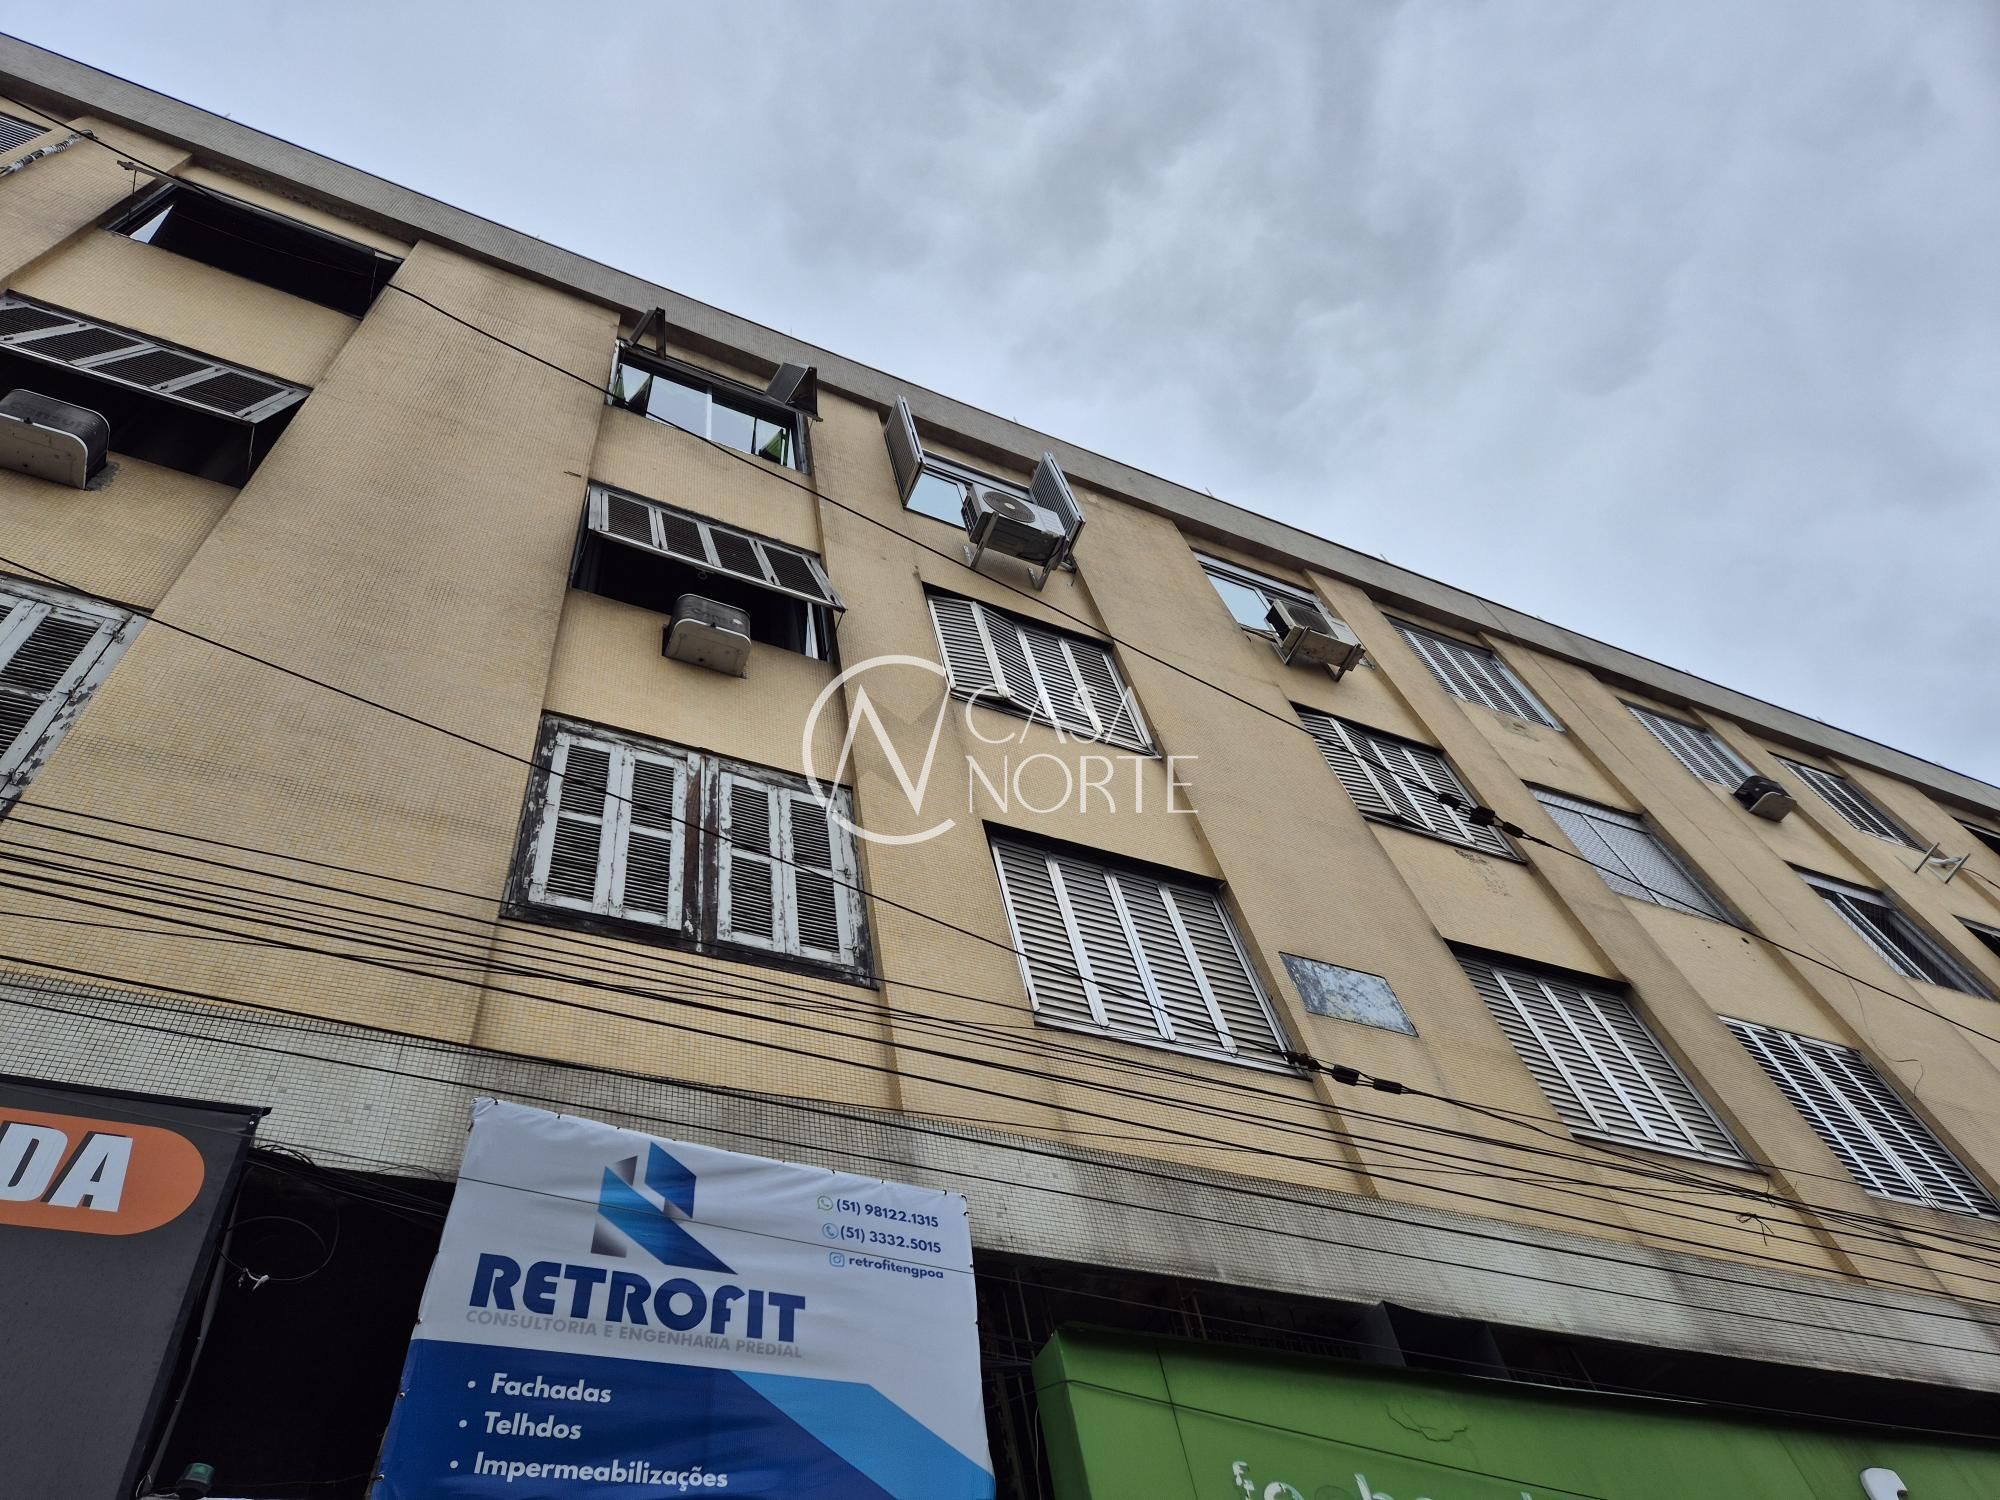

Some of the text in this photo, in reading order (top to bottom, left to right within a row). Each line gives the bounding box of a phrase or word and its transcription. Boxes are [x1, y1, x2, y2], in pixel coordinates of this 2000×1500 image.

[837, 1198, 939, 1228] (51) 98122.1315
[840, 1225, 942, 1253] (51) 3332.5015
[848, 1257, 944, 1279] retrofitengpoa
[469, 1253, 806, 1342] RETROFIT
[465, 1310, 803, 1358] CONSULTORIA E ENGENHARIA PREDIAL
[490, 1372, 612, 1403] Fachadas
[484, 1411, 582, 1440] Telhdos
[473, 1451, 729, 1491] Impermeabilizações
